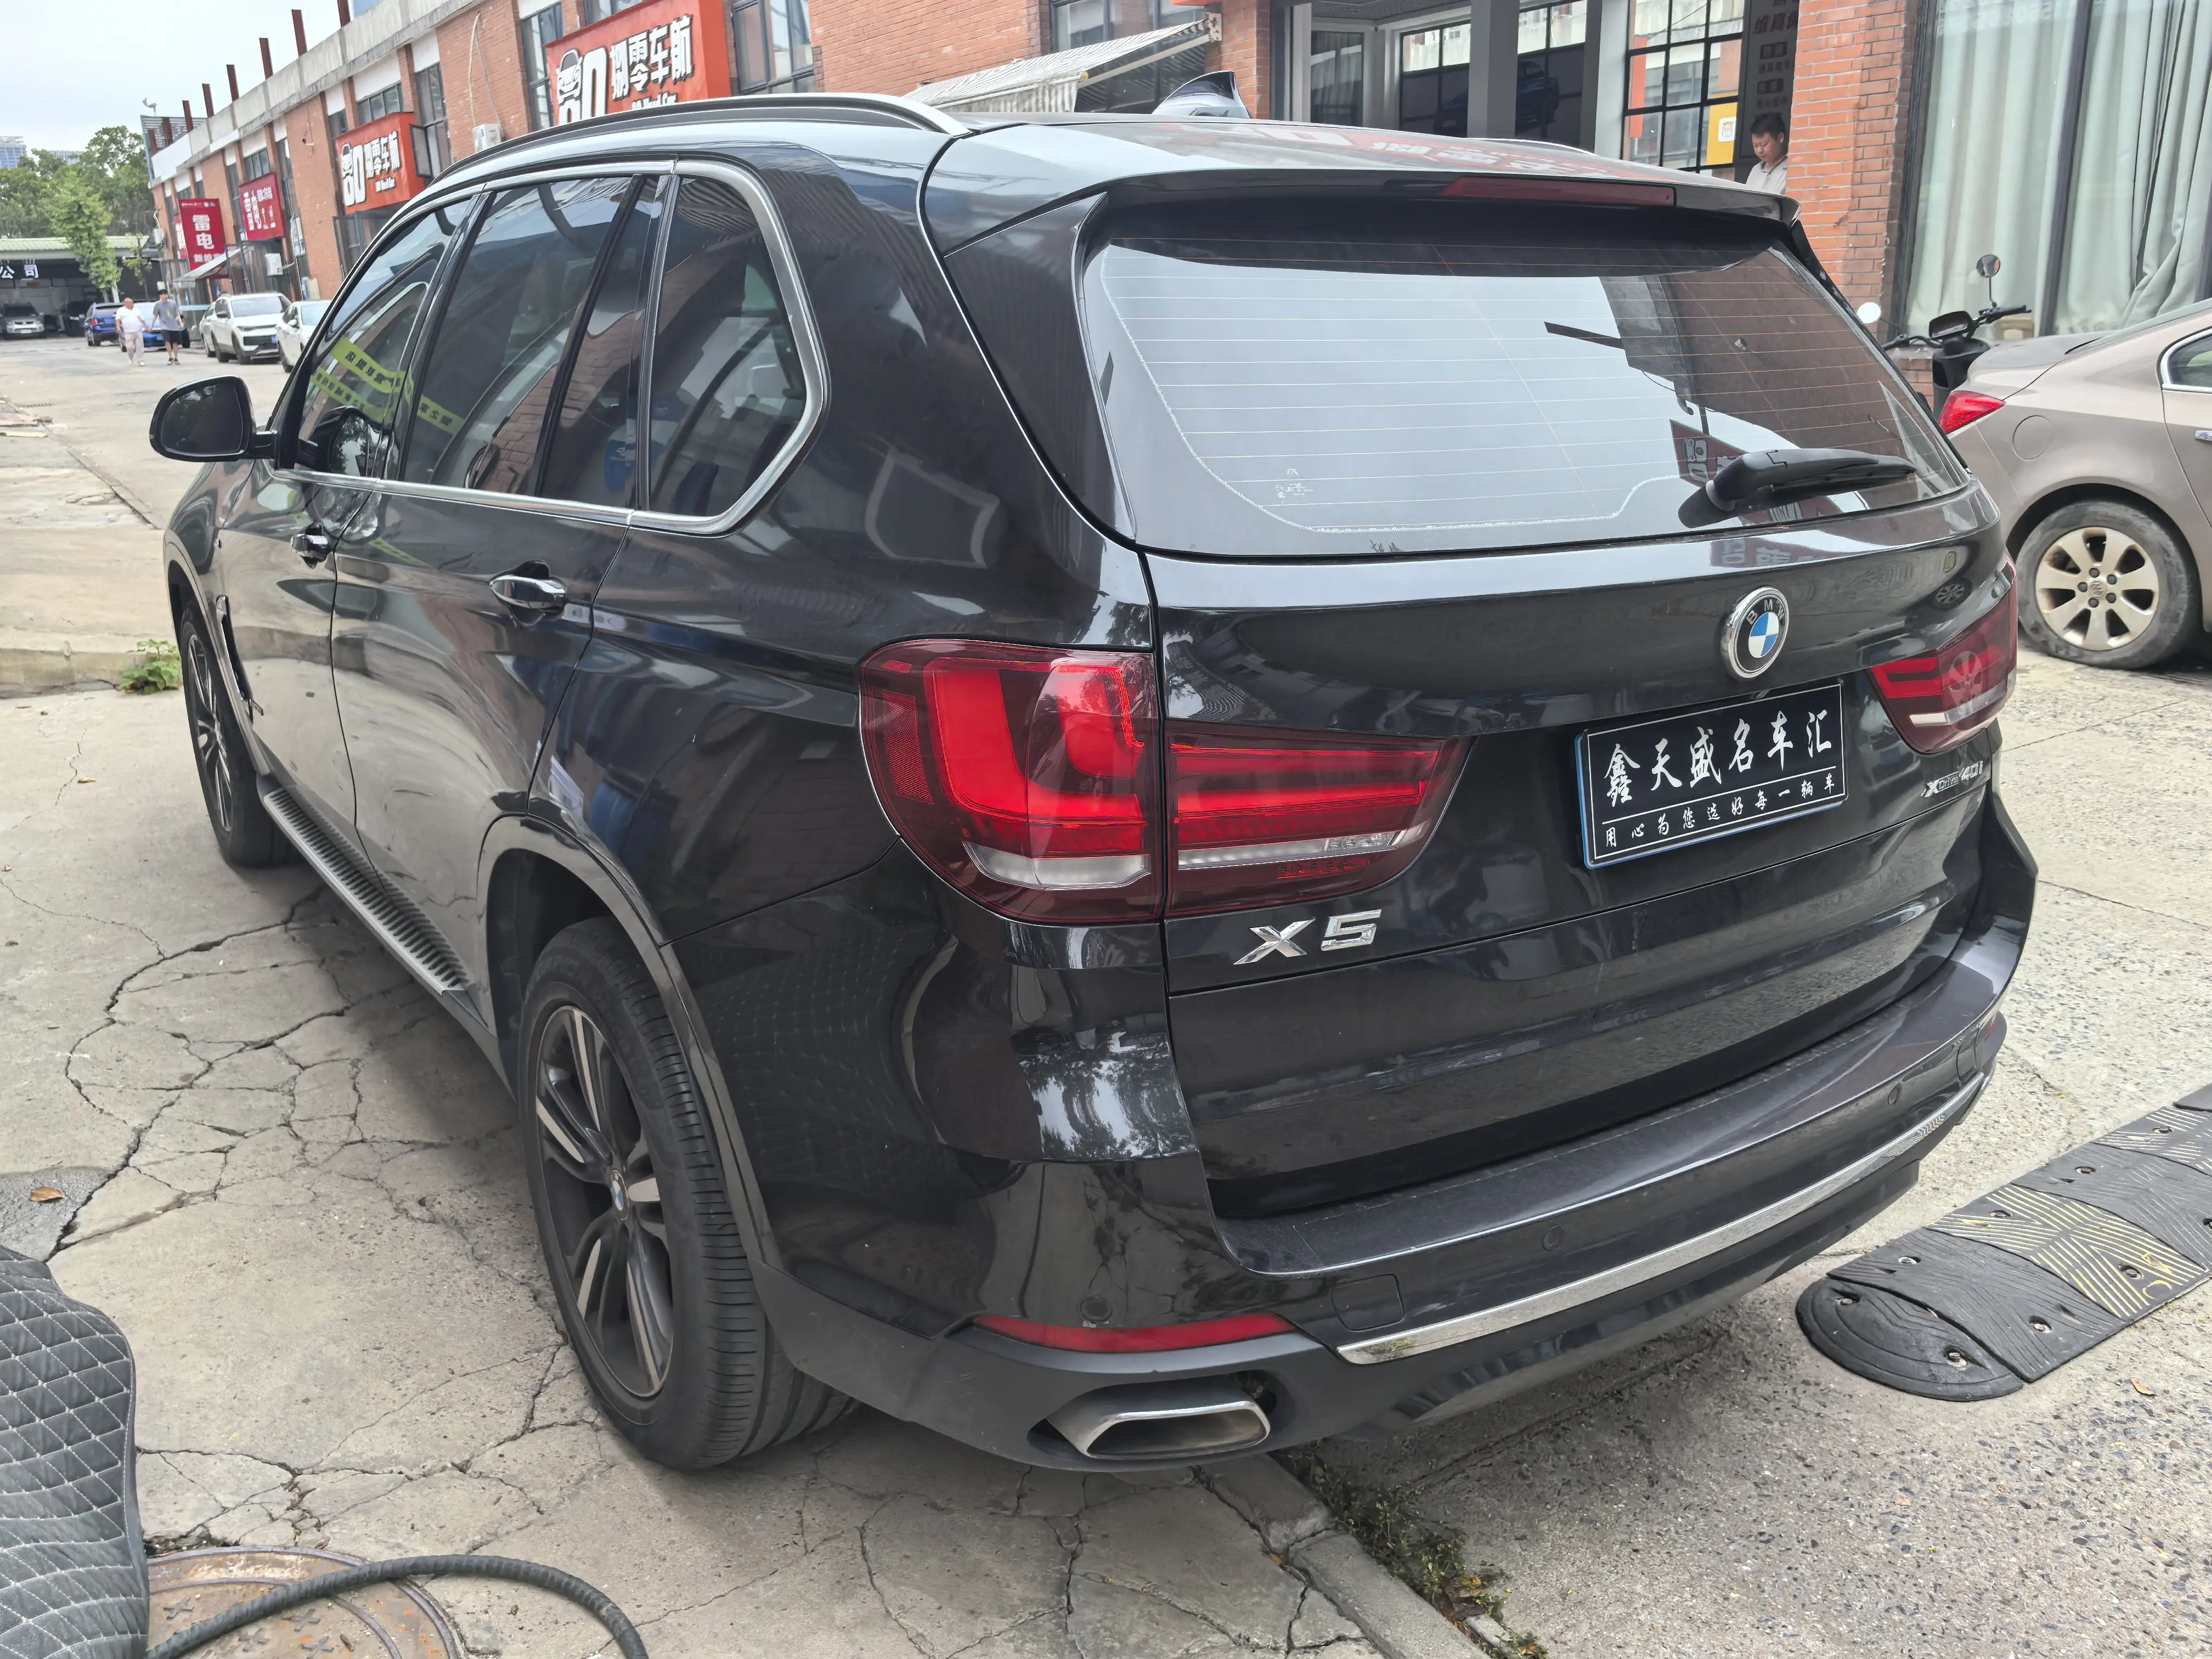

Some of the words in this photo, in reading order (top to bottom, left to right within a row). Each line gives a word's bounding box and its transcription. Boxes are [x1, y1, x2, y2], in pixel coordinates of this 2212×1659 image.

[193, 214, 214, 249] 雷电
[0, 265, 39, 279] 公司
[1745, 598, 1785, 625] BMW
[1604, 710, 1832, 808] 鑫天盛名车汇
[1605, 773, 1835, 847] 用心为您选好每一辆车
[1233, 909, 1382, 965] X5
